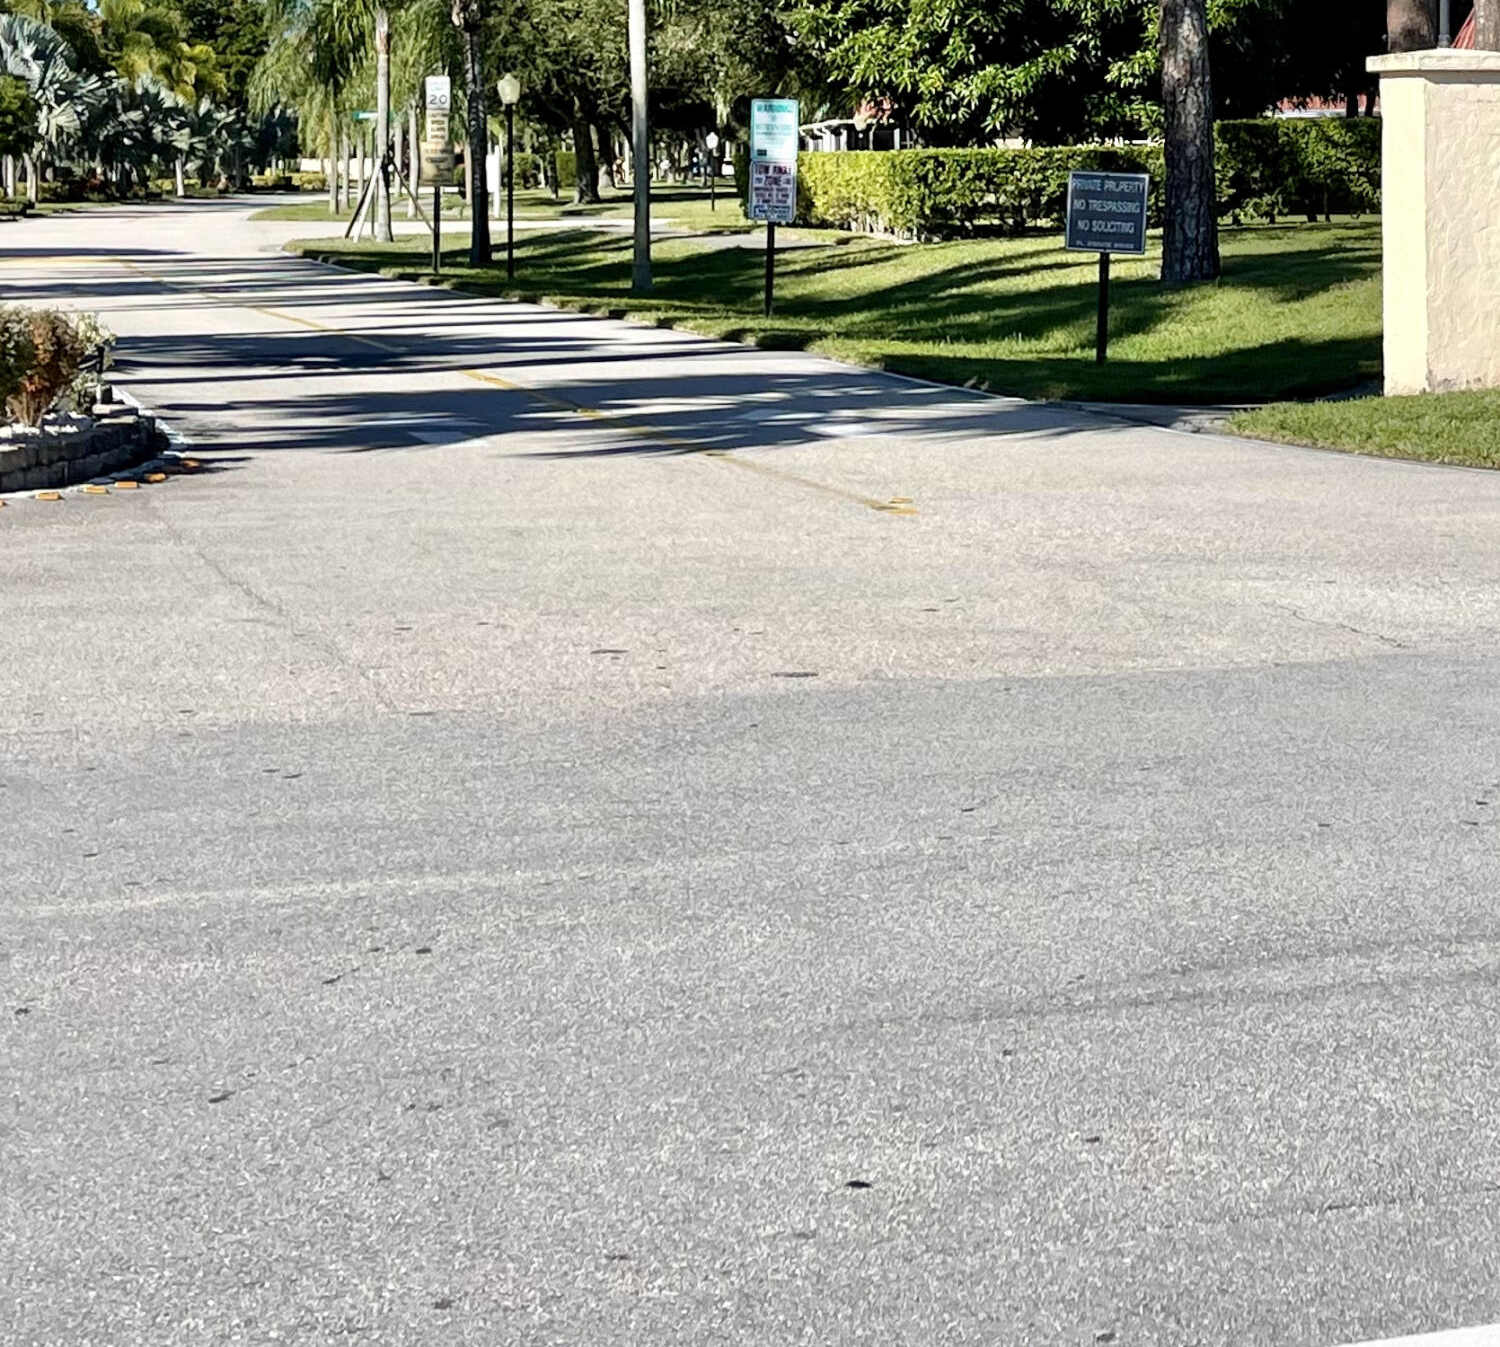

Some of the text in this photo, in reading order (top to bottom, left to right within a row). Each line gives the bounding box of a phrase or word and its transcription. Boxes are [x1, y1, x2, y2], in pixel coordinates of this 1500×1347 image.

[428, 94, 448, 105] 20
[1073, 178, 1145, 193] PRIVATE PROPERTY
[1073, 198, 1141, 213] NO TRESPASSING
[1077, 219, 1135, 234] NO SOLICITING
